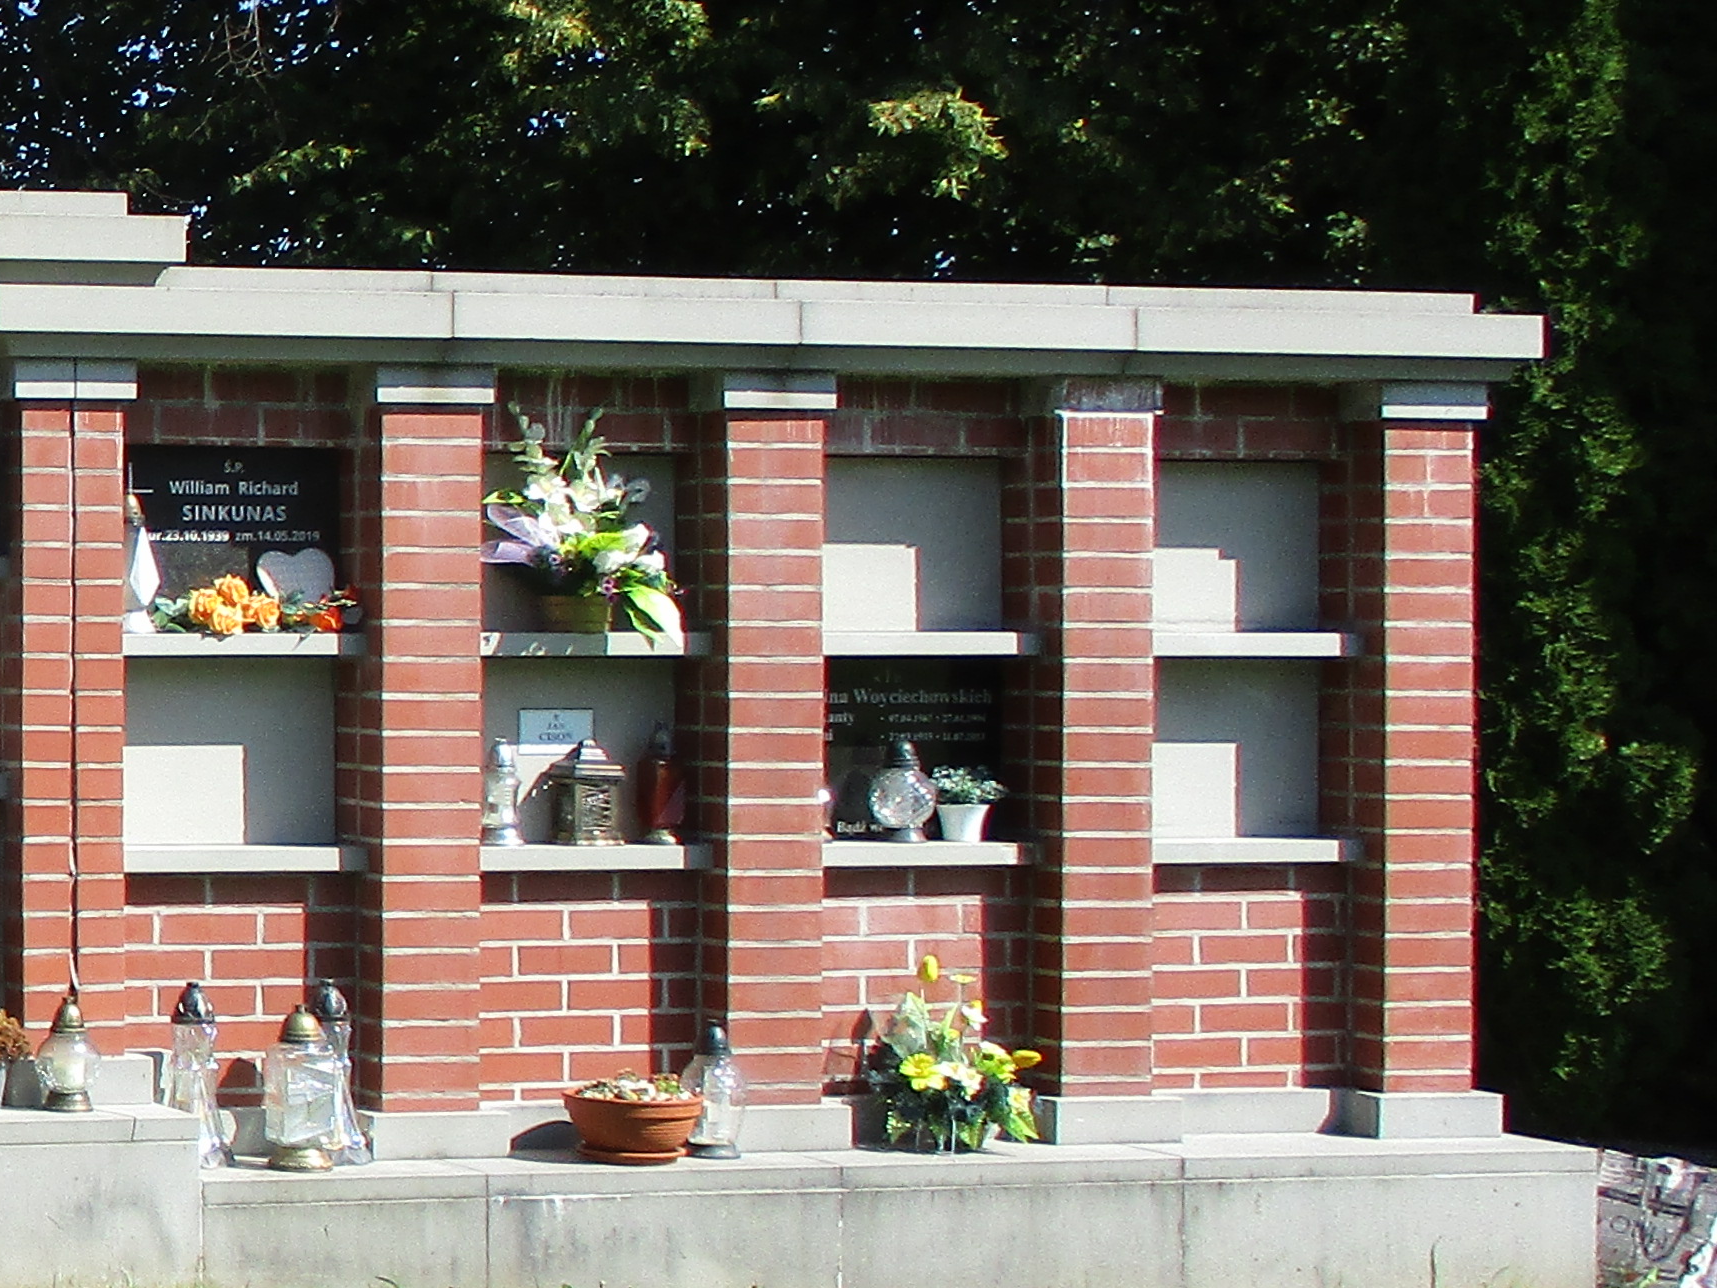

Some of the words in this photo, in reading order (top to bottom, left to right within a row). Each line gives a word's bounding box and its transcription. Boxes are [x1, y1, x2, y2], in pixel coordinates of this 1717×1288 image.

[168, 480, 230, 496] William
[238, 480, 299, 496] Richard
[182, 505, 287, 523] SINKUNAS
